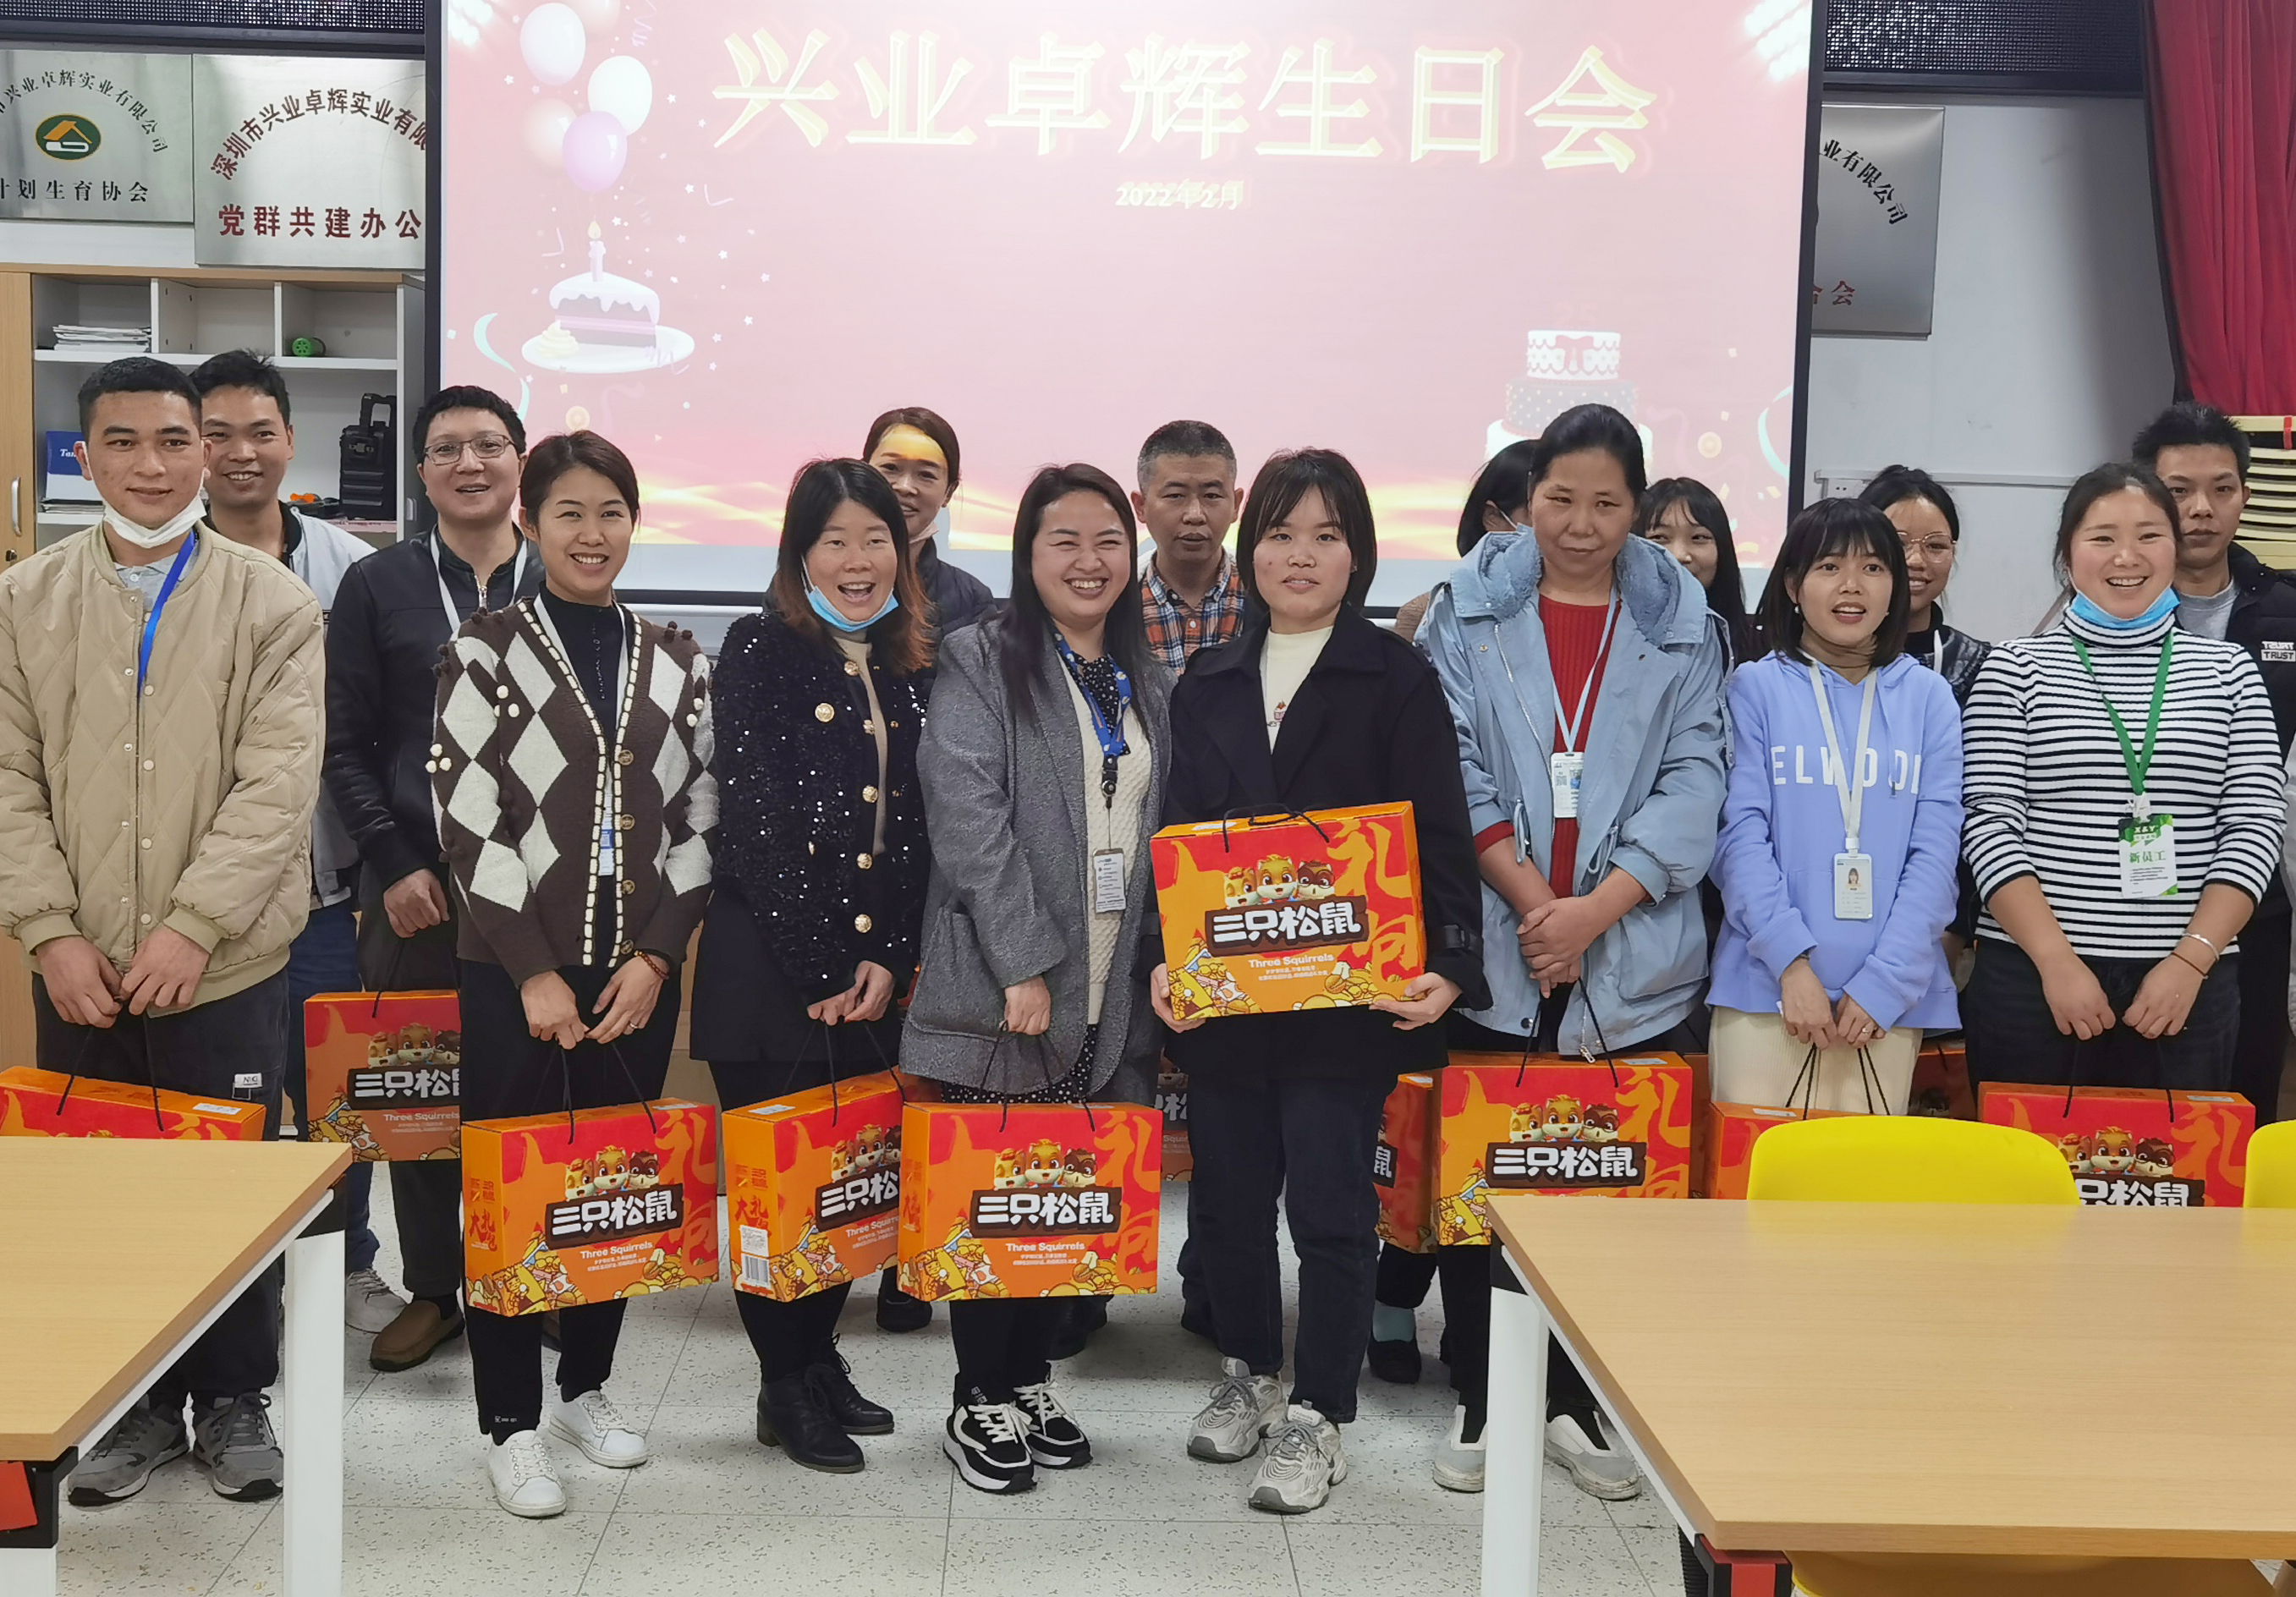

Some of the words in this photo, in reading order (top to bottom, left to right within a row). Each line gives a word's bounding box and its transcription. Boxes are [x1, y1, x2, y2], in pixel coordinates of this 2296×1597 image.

[711, 28, 1658, 173] 兴业卓辉生日会
[1116, 178, 1244, 211] 2022年2月
[1820, 140, 1908, 224] 业有限公司
[218, 204, 421, 239] 党群共建办公
[2263, 651, 2293, 660] TRUST
[1213, 902, 1361, 942] 三只松鼠
[1248, 958, 1282, 969] Three
[1283, 952, 1335, 966] Squirrels
[383, 1113, 413, 1122] Three
[1493, 1146, 1637, 1178] 三只松鼠
[821, 1170, 898, 1217] 三只松
[977, 1192, 1113, 1226] 三只松鼠
[552, 1190, 677, 1236] 三只松鼠
[579, 1249, 608, 1259] Three
[610, 1241, 653, 1254] Squirrels
[1005, 1243, 1036, 1252] Three
[1038, 1241, 1085, 1252] Squirrels
